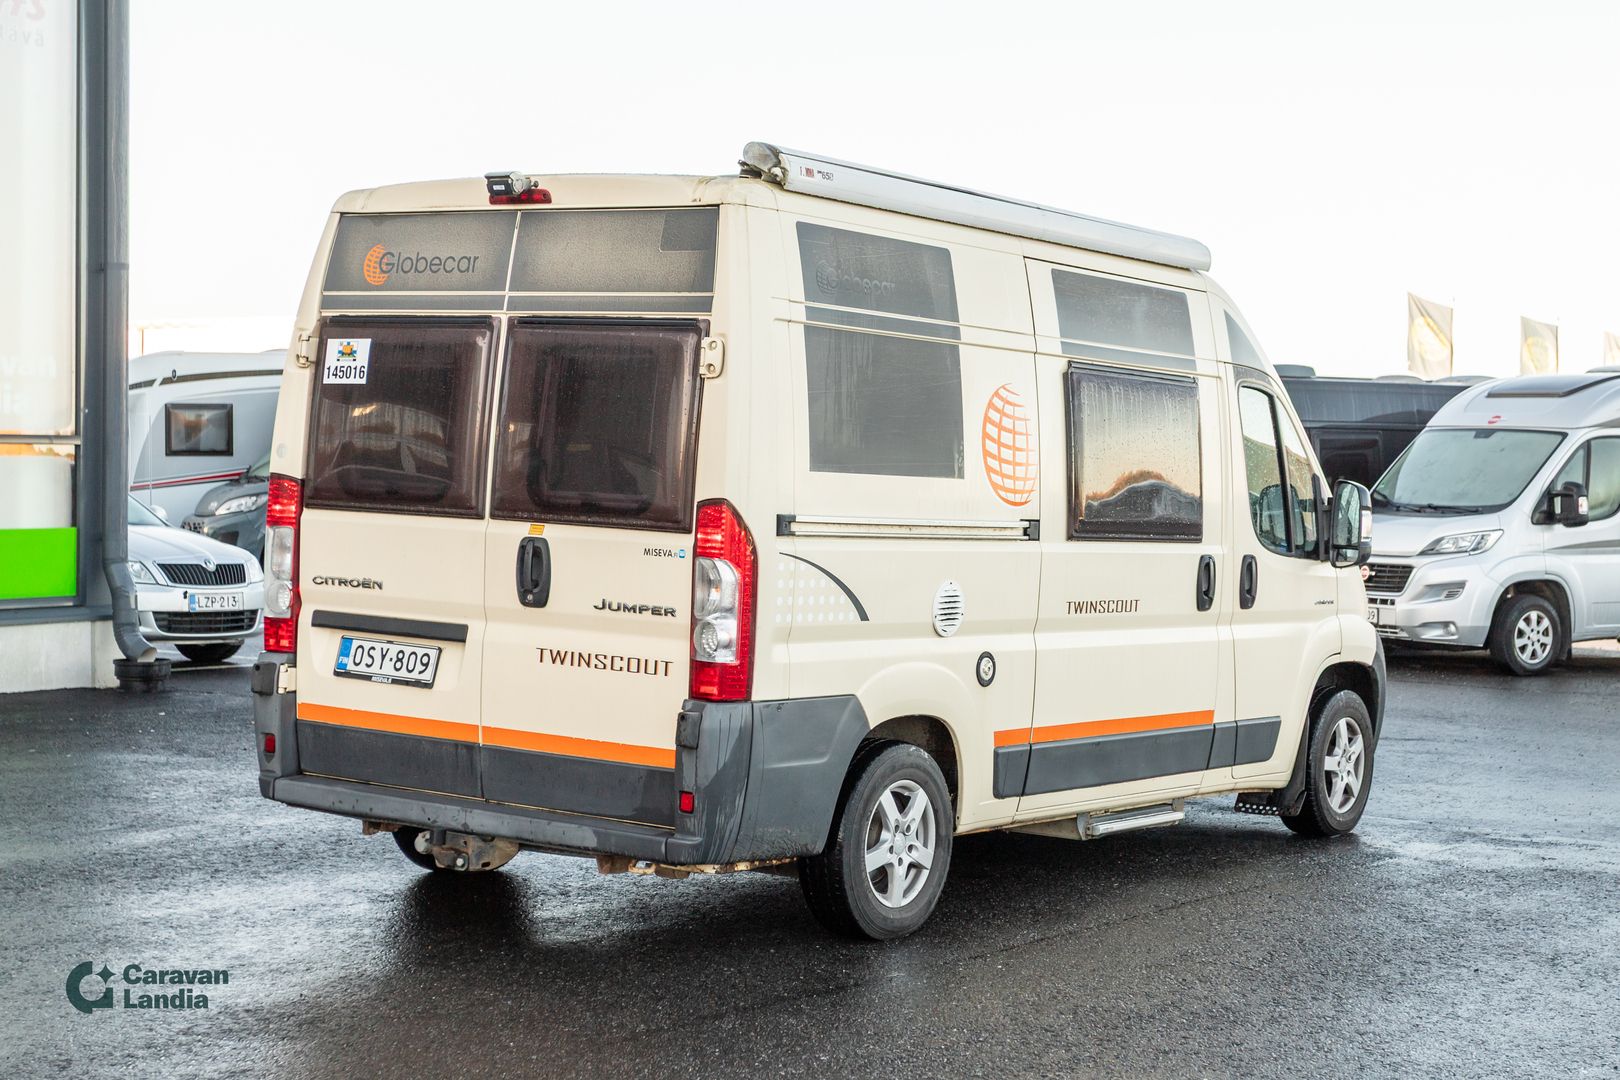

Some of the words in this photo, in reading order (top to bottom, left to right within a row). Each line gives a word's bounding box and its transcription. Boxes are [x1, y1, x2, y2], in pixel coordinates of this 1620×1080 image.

[378, 251, 480, 275] Globecar
[326, 365, 366, 380] 145016
[312, 576, 383, 590] CITROËN
[198, 597, 236, 608] LZP-213
[1066, 599, 1140, 615] TWINSCOUT
[352, 644, 431, 675] OSY-809
[536, 647, 674, 678] TWINSCOUT
